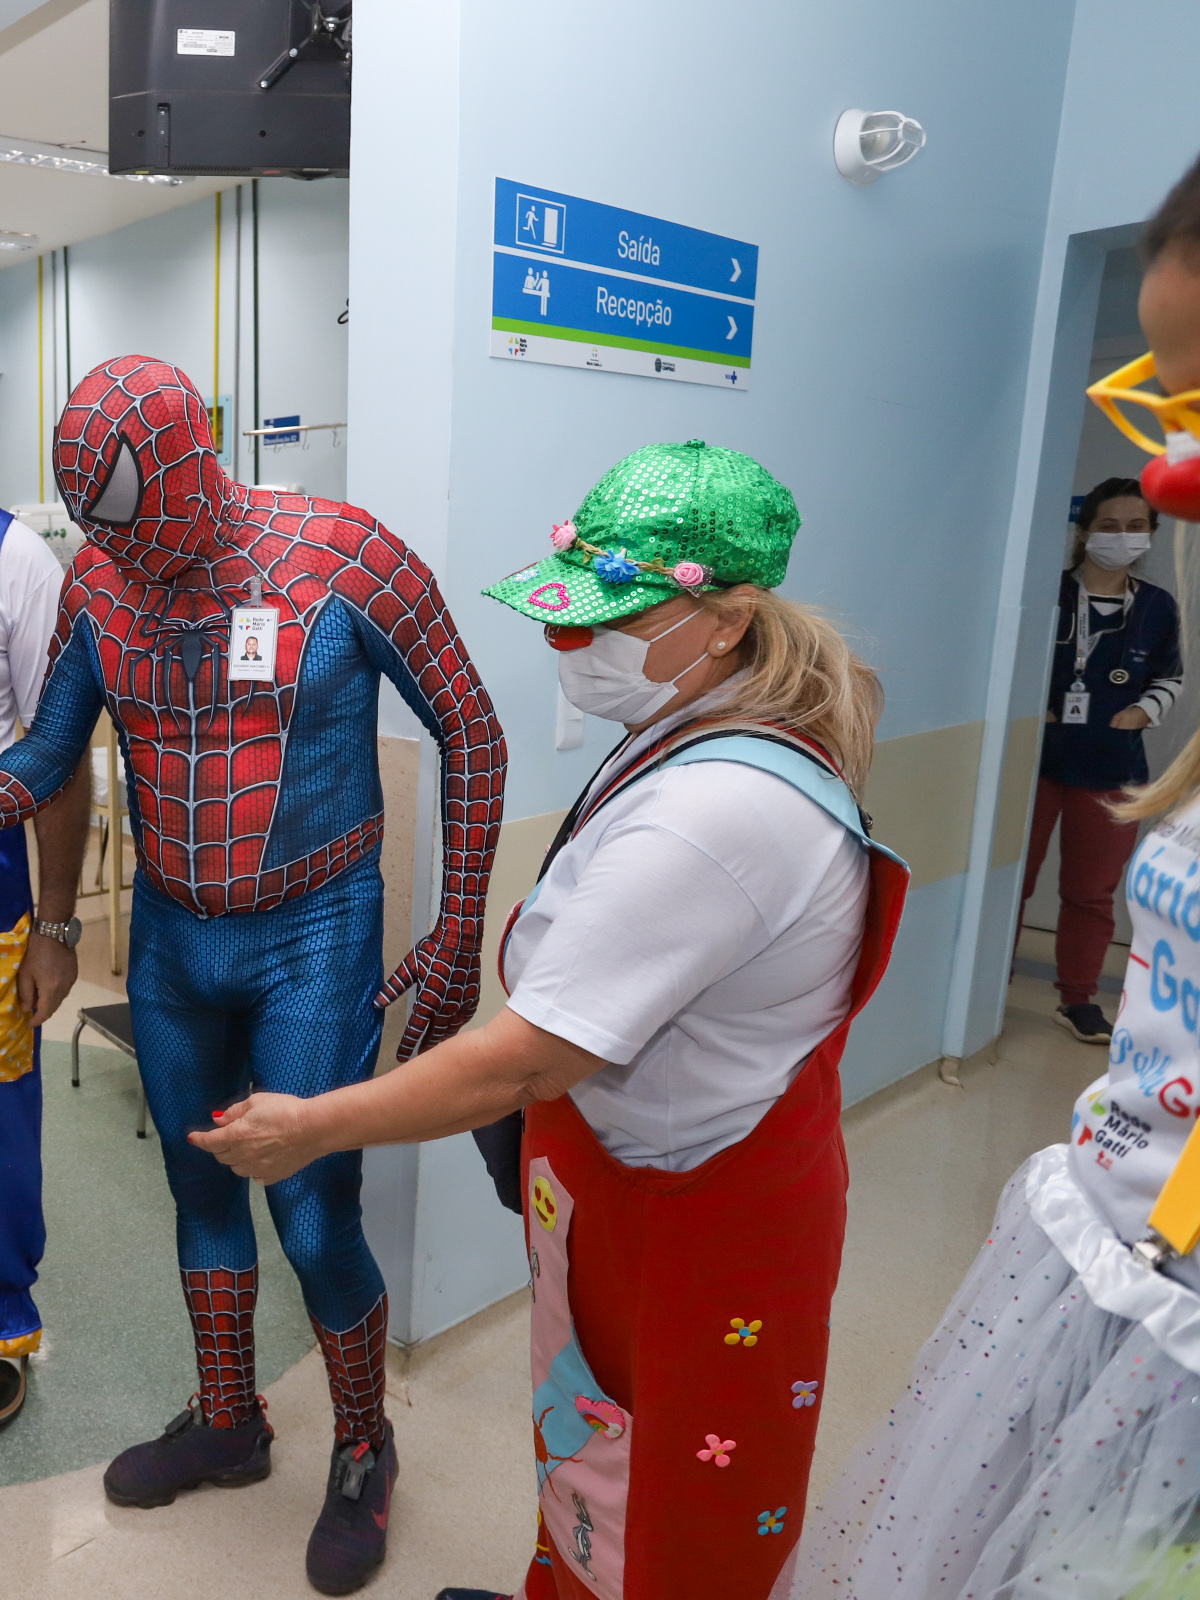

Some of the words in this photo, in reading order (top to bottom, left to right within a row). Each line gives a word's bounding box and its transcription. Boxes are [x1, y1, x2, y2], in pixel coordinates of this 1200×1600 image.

[617, 230, 661, 267] Saída
[595, 286, 673, 328] Recepção
[1095, 1129, 1132, 1159] Gatti
[1103, 1115, 1149, 1149] Mário
